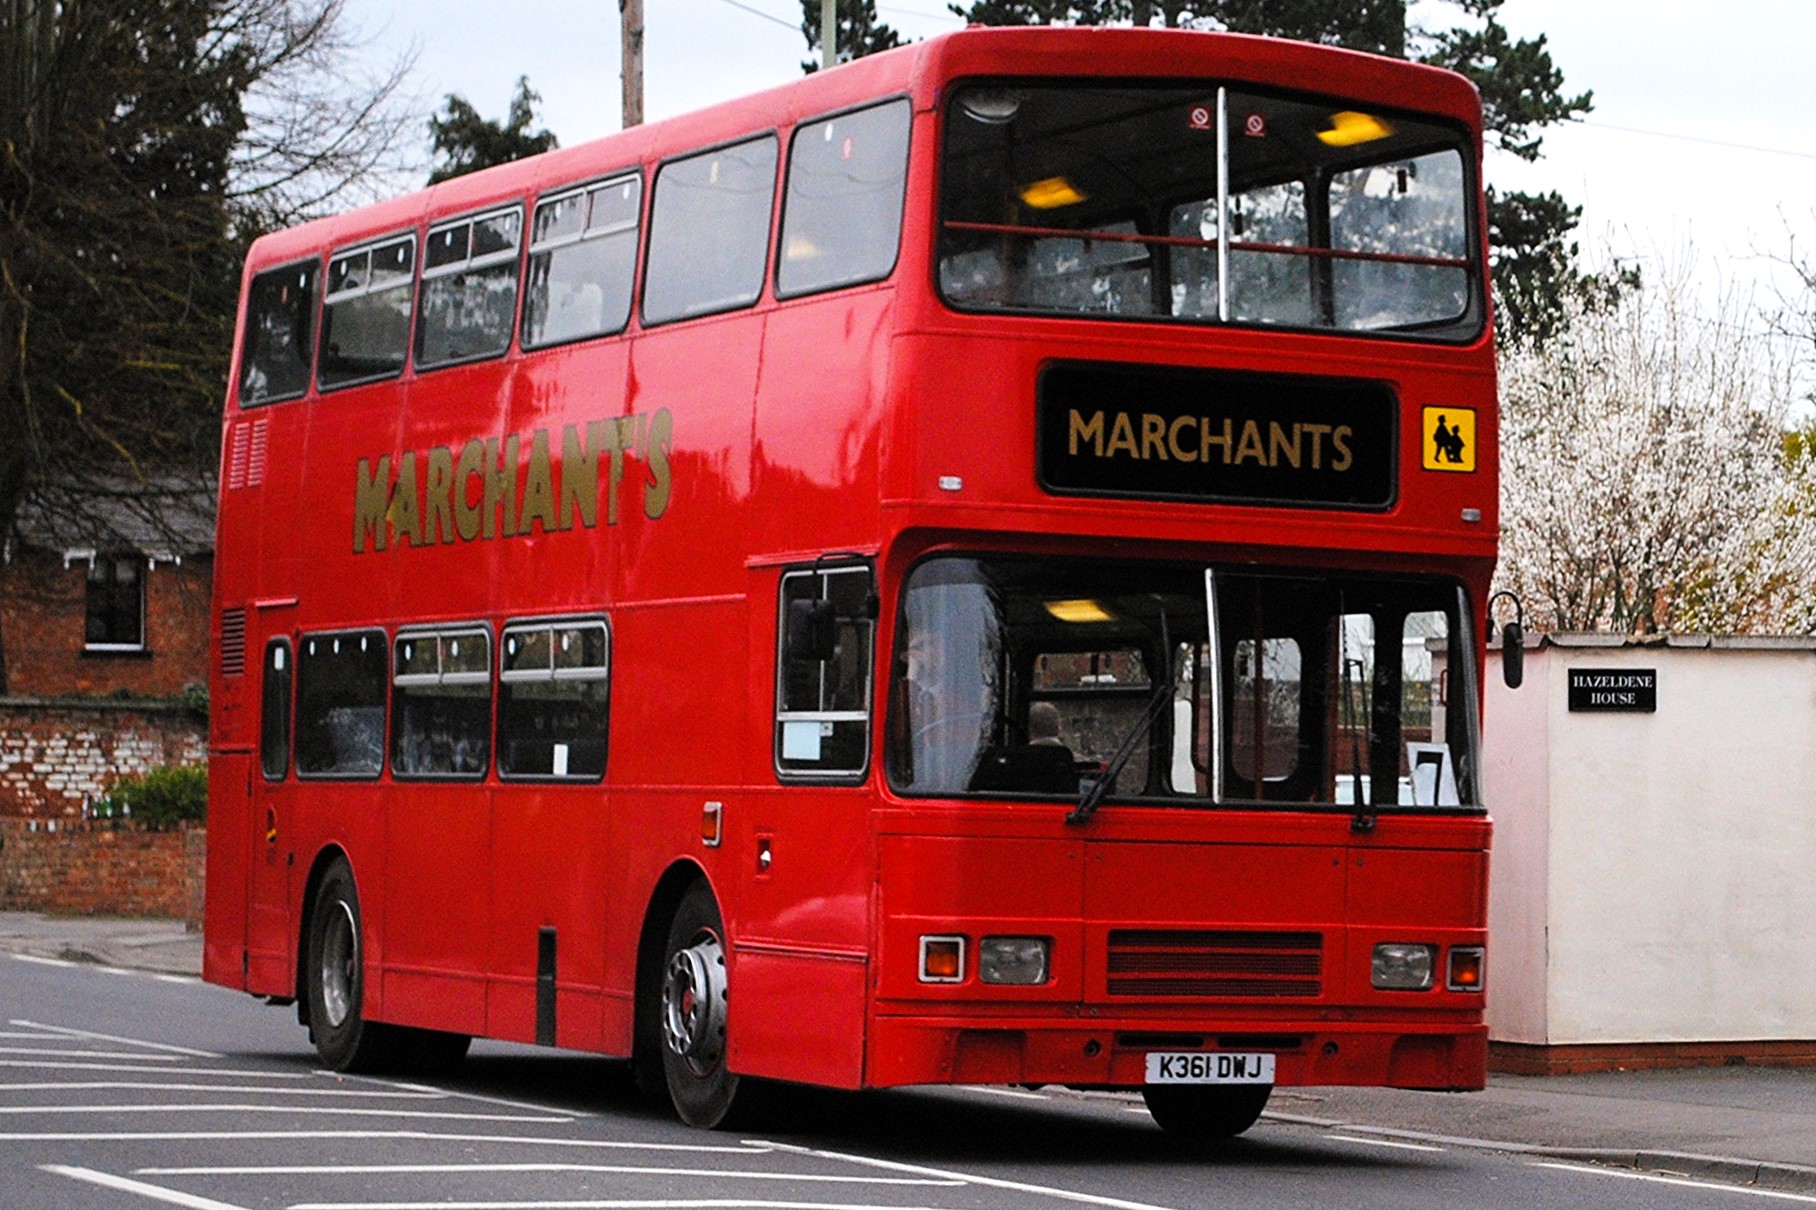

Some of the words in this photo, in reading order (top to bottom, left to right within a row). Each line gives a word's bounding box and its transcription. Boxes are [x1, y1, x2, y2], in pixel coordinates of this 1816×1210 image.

[1068, 409, 1352, 471] MARCHANTS
[352, 406, 673, 554] MARCHANT'S
[1573, 675, 1652, 688] HAZELDENE
[1591, 692, 1636, 704] HOUSE
[1159, 1055, 1210, 1078] K361
[1217, 1055, 1261, 1078] DWJ
